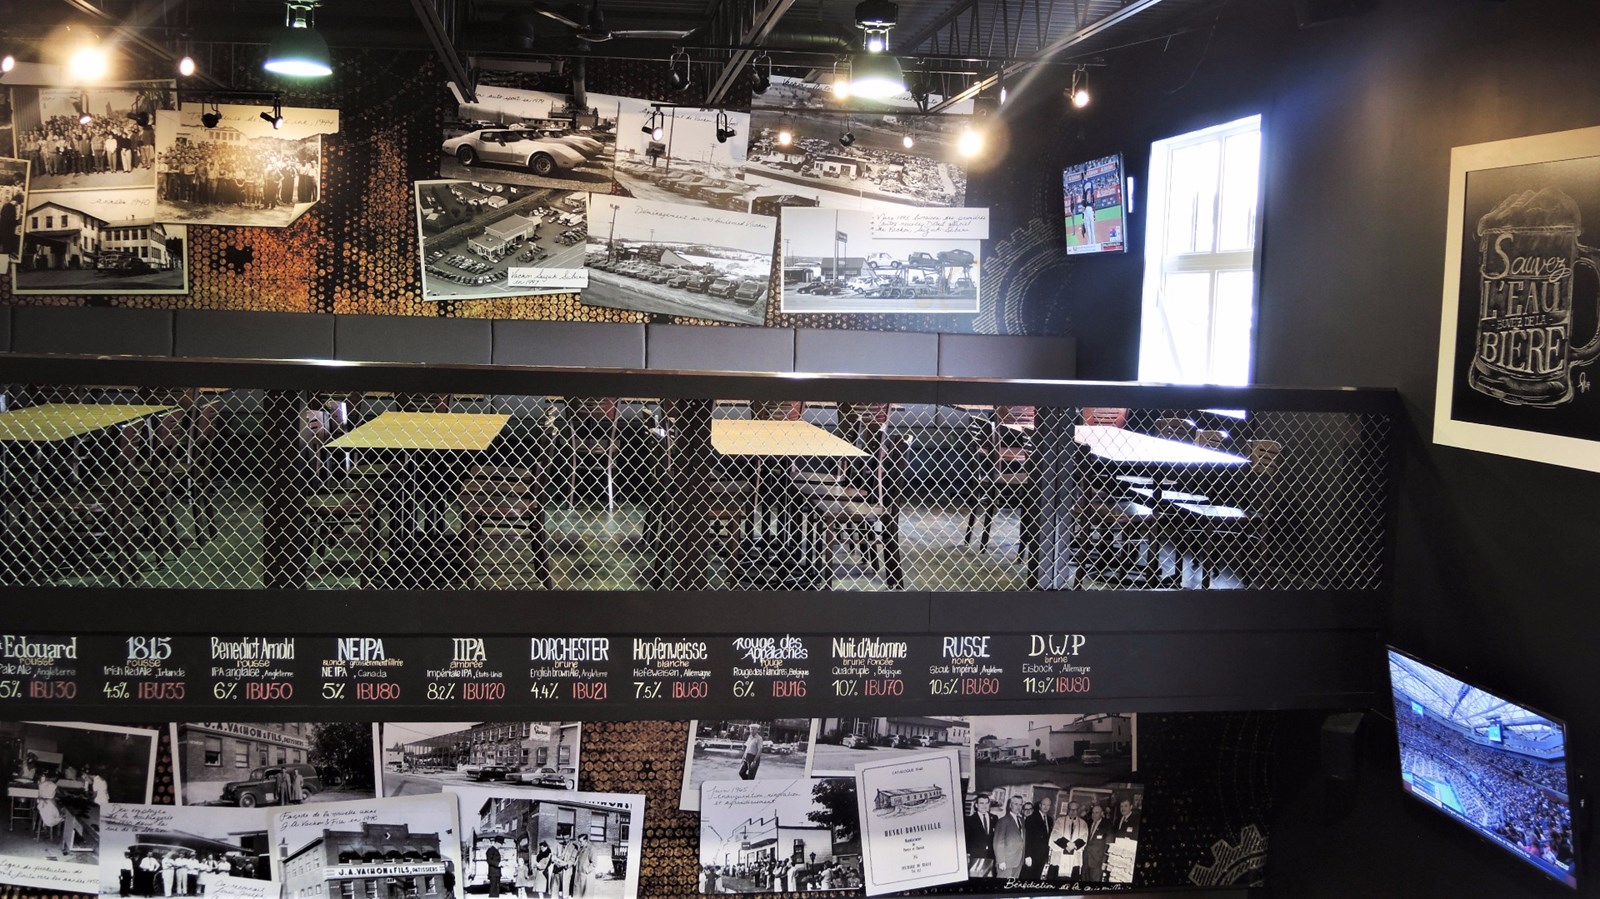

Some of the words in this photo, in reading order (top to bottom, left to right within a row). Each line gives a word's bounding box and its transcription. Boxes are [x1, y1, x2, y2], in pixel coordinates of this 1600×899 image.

[1481, 233, 1574, 282] Sauvez
[1482, 279, 1562, 321] L'EAU
[126, 636, 172, 660] 1815
[211, 636, 260, 660] Benedict
[260, 638, 295, 660] Arnold
[338, 638, 385, 660] NEIPA
[452, 638, 487, 661] IIPA
[531, 638, 610, 661] DORCHESTER
[732, 637, 775, 650] Rouge
[780, 634, 802, 650] des
[832, 637, 857, 658] Nuit
[858, 637, 908, 659] d'Automne
[943, 636, 991, 658] RUSSE
[633, 637, 708, 665] Hopfenweisse
[19, 658, 54, 666] rousse
[126, 659, 161, 667] rousse
[450, 660, 484, 668] ambrée
[554, 660, 578, 668] brune
[762, 659, 783, 668] rouge
[952, 657, 974, 665] noire
[1044, 656, 1068, 664] brune
[17, 664, 32, 674] Ale
[104, 666, 124, 676] Irish
[226, 668, 260, 680] anglaise
[426, 669, 461, 680] Impériale
[530, 668, 552, 680] English
[633, 668, 680, 677] Hefeweisen
[832, 666, 870, 678] Quadruple
[930, 665, 950, 674] Stout
[952, 665, 978, 676] Impérial
[1022, 664, 1053, 673] Eisbock
[138, 682, 186, 699] IBU35
[214, 682, 238, 700] 6%
[246, 682, 294, 700] IBU50
[322, 682, 346, 700] 5%
[356, 683, 400, 700] IBU80
[427, 682, 456, 700] 8.2%
[464, 683, 506, 700] IBU120
[531, 682, 559, 700] 4.4%
[572, 682, 607, 700] IBU21
[634, 682, 662, 698] 7.5%
[672, 682, 708, 698] IBU80
[733, 680, 755, 698] 6%
[772, 681, 806, 698] IBU16
[832, 680, 858, 696] 10%
[864, 680, 904, 696] IBU70
[929, 678, 958, 694] 10.5%
[962, 678, 1000, 694] IBU80
[1024, 677, 1054, 694] 11.9%
[1056, 677, 1090, 692] IBU80
[884, 828, 903, 838] HENRI
[906, 822, 942, 834] BONNEVILLE
